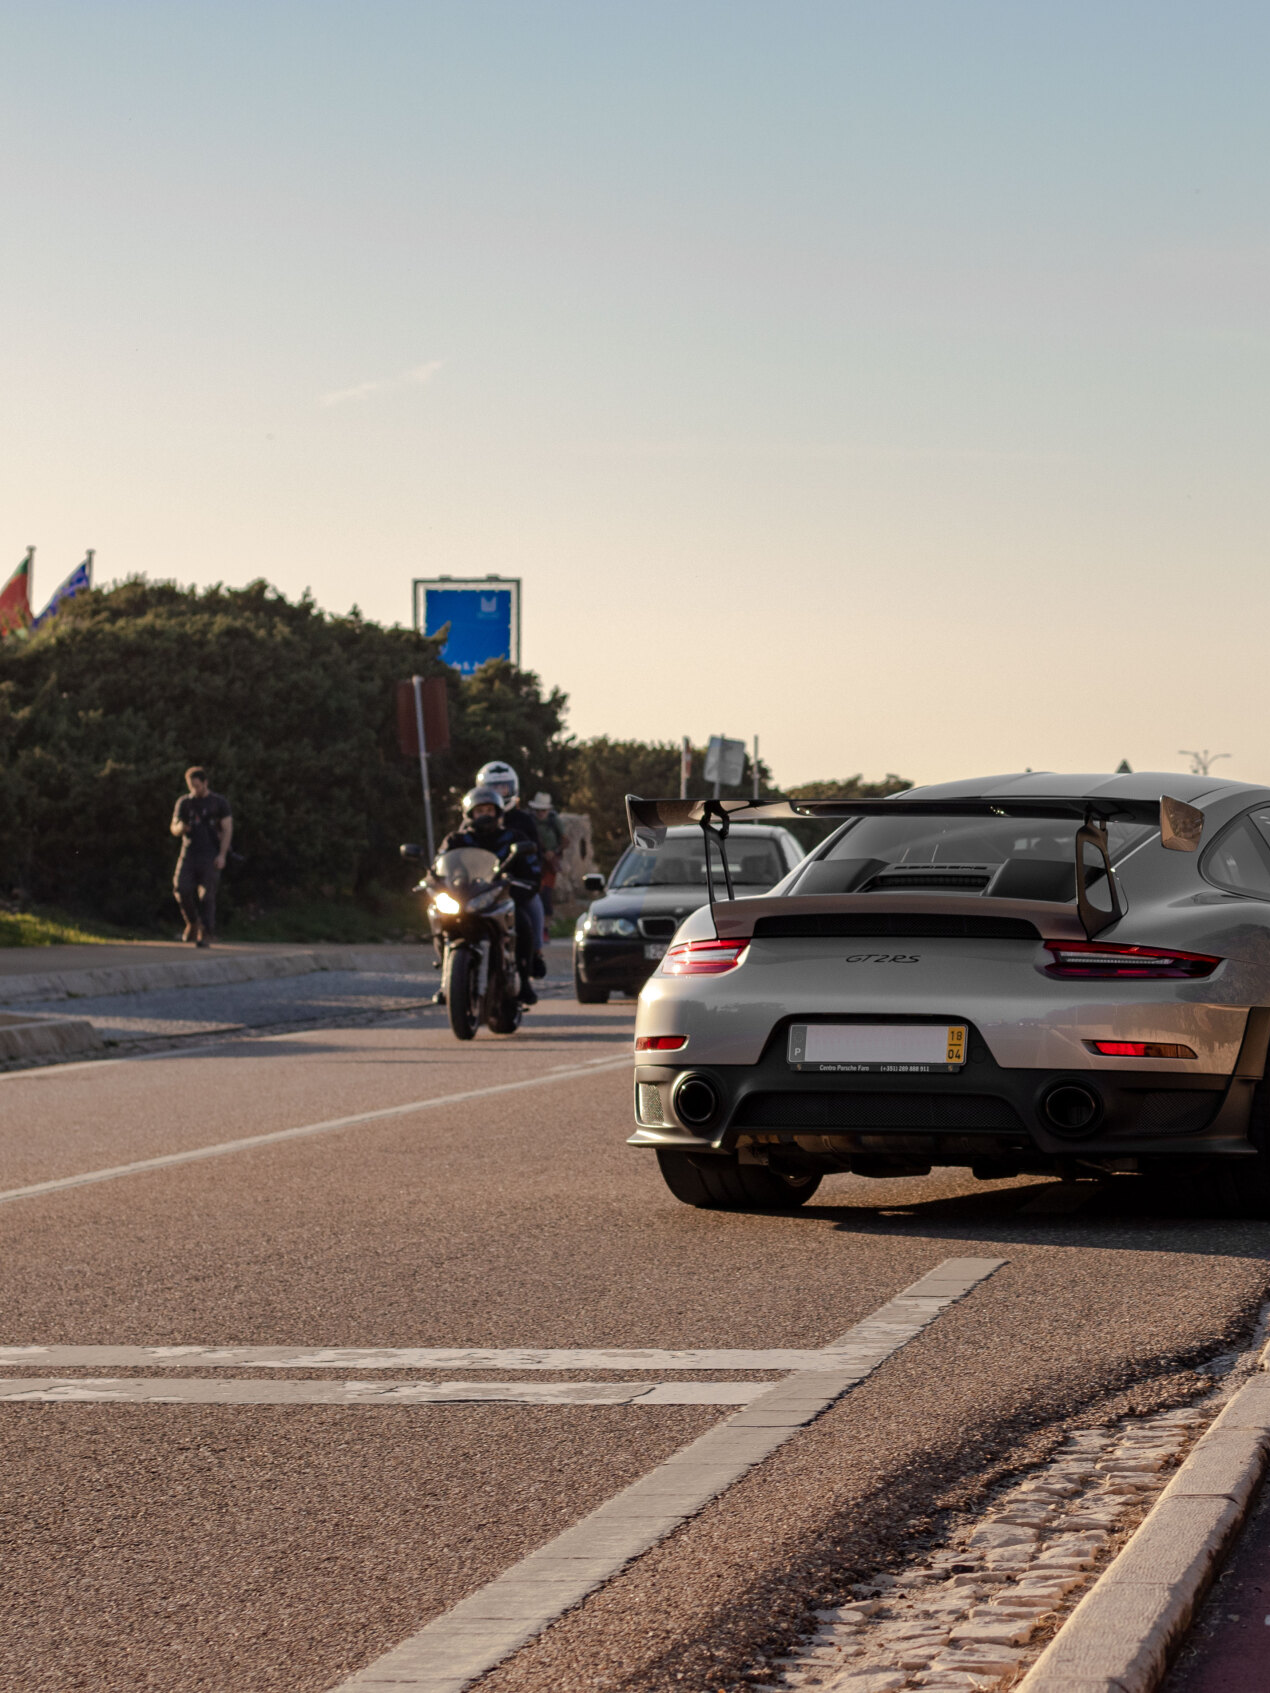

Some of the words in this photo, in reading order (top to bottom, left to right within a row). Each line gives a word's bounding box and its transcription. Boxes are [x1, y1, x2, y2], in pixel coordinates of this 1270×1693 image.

[950, 1030, 963, 1041] 18
[794, 1047, 801, 1056] P
[947, 1049, 961, 1060] 04
[858, 1064, 870, 1072] Faro
